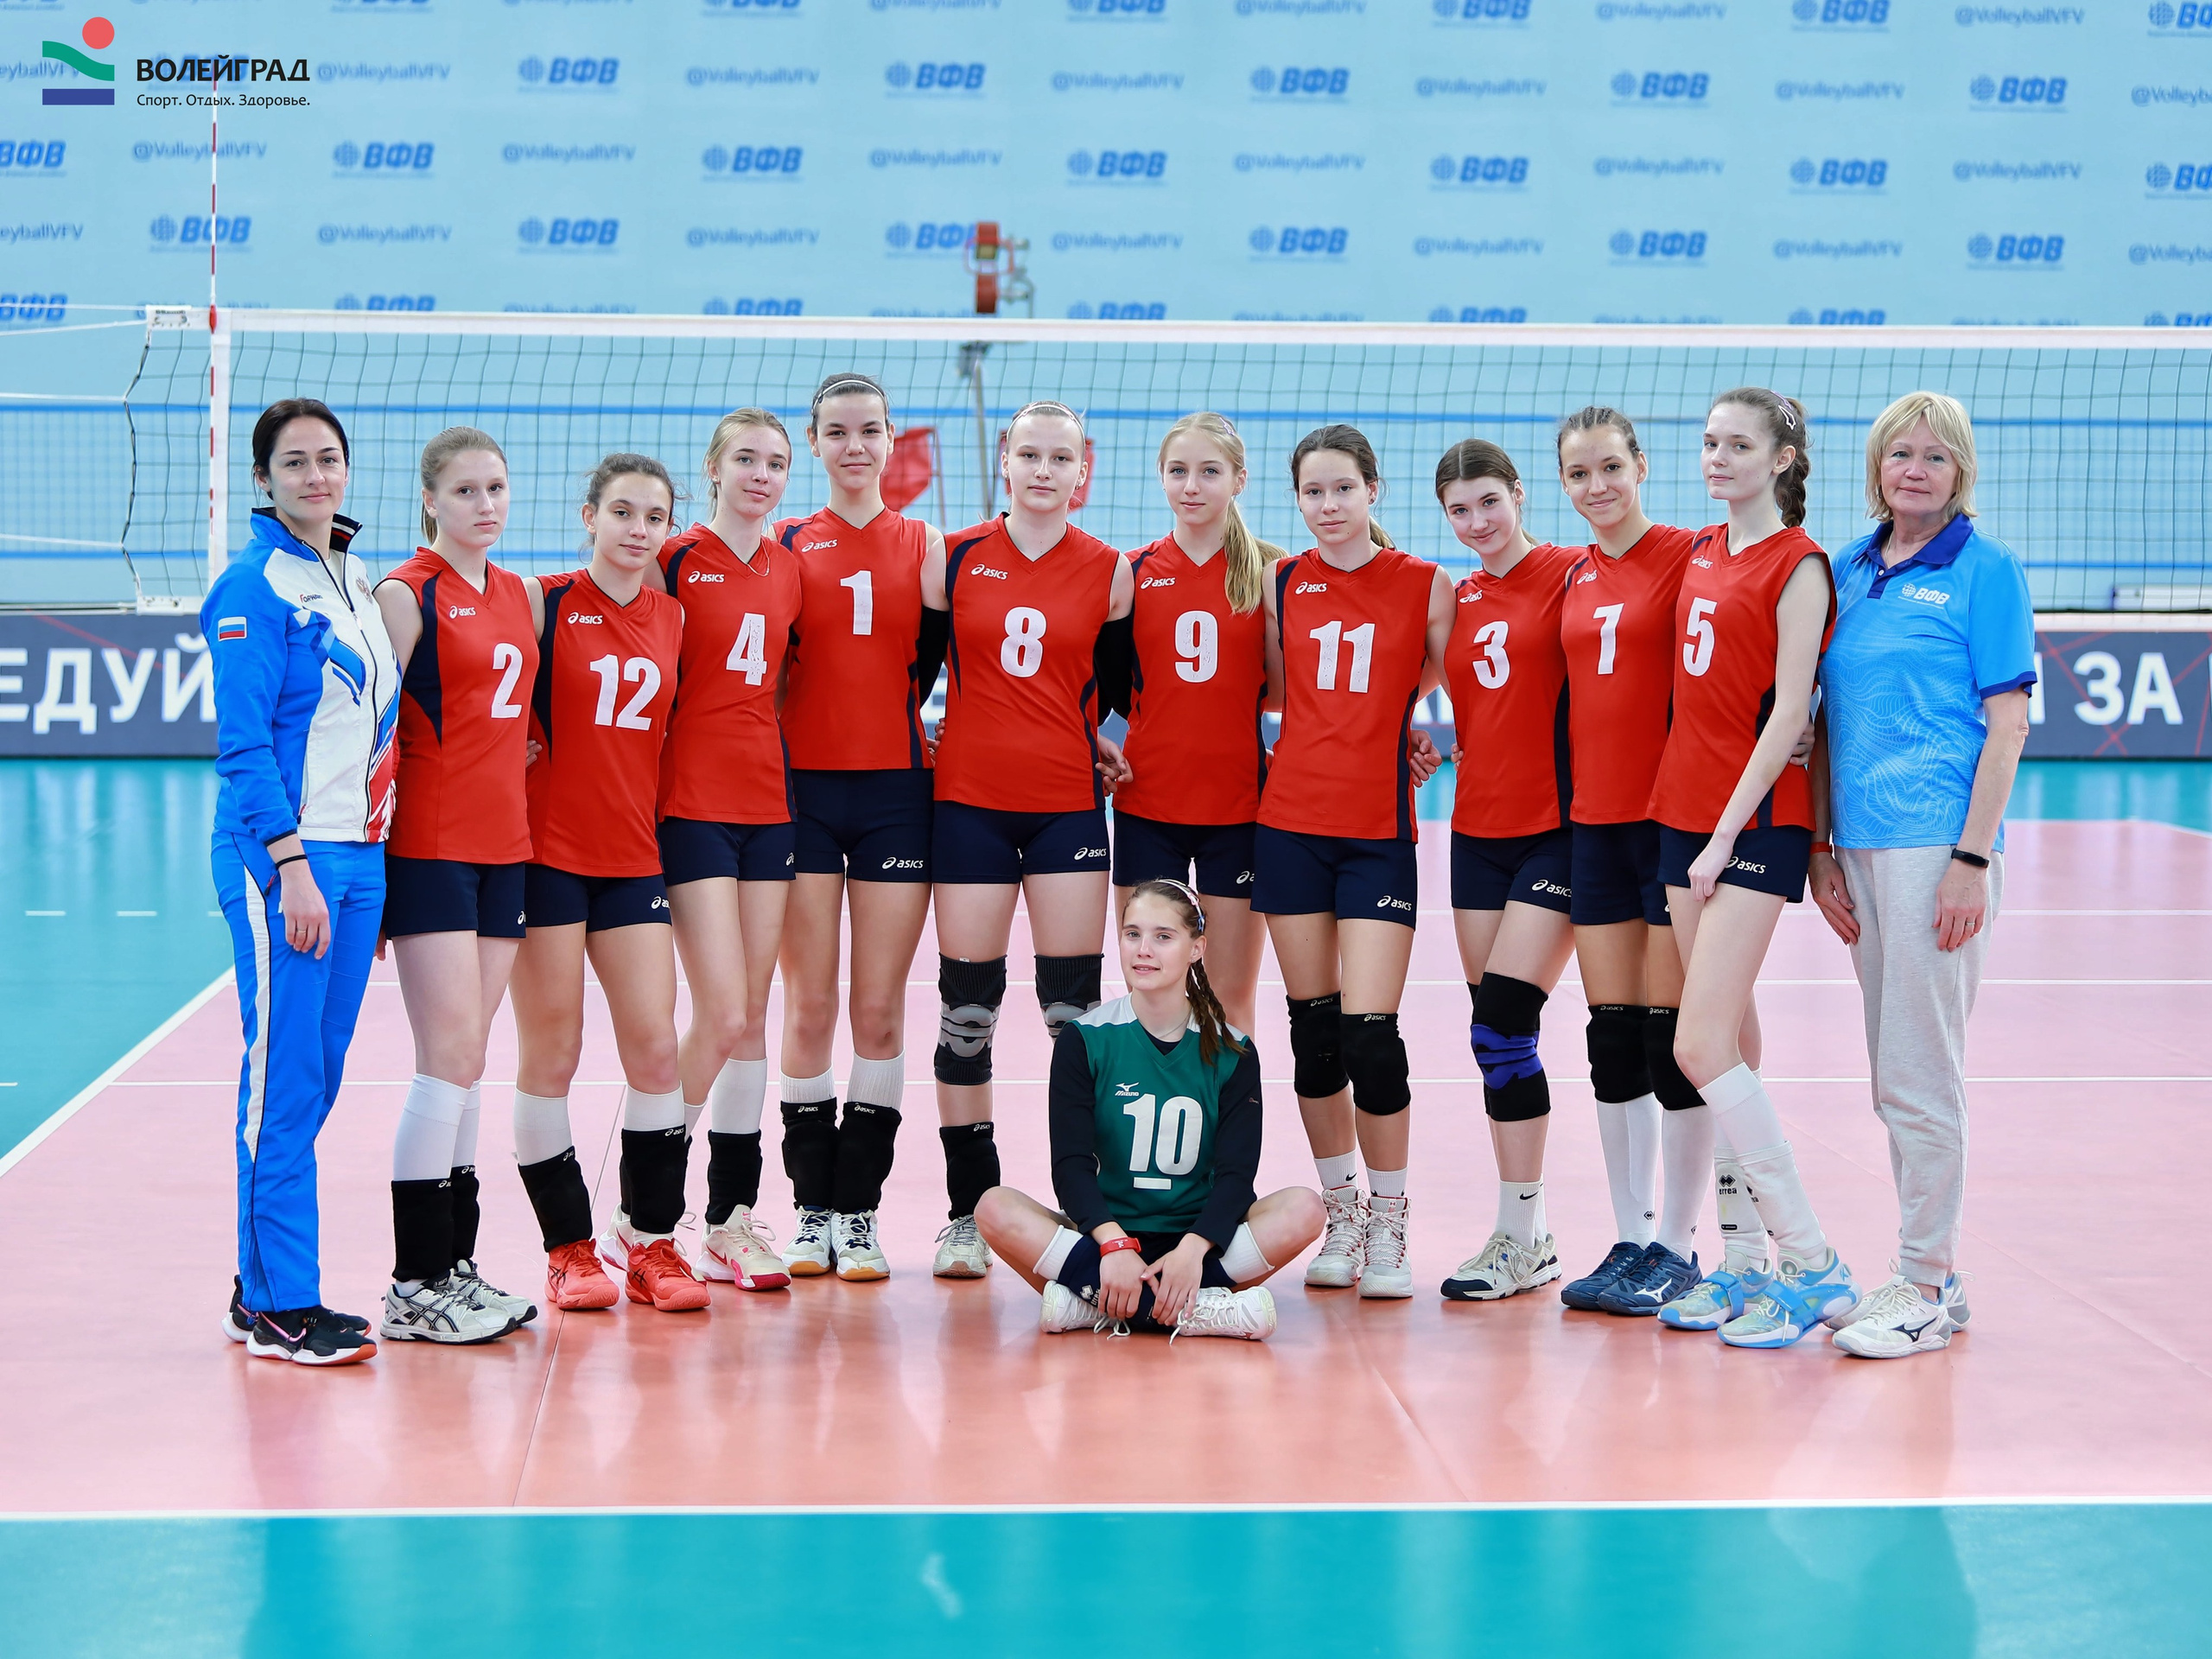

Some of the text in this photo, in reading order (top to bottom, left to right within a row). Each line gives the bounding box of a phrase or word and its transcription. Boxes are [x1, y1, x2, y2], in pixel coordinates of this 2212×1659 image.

[547, 57, 620, 86] ВФВ
[913, 62, 987, 91] ВФВ
[1278, 67, 1351, 96] ВФВ
[1639, 72, 1711, 101] ВФВ
[1998, 76, 2069, 105] ВФВ
[362, 142, 435, 171] ВФВ
[730, 145, 804, 175] ВФВ
[1096, 150, 1168, 180] ВФВ
[1458, 156, 1529, 185] ВФВ
[1818, 159, 1889, 188] ВФВ
[179, 215, 252, 245] ВФВ
[547, 218, 620, 247] ВФВ
[1277, 226, 1349, 256] ВФВ
[1637, 230, 1708, 259] ВФВ
[1995, 234, 2065, 263] ВФВ
[813, 539, 837, 550] asics
[700, 573, 725, 583] asics
[982, 567, 1008, 580] asics
[1152, 577, 1176, 588] asics
[1306, 582, 1327, 594] asics
[840, 569, 874, 636] 1
[1913, 588, 1950, 605] ВФВ
[458, 607, 476, 617] asics
[578, 613, 603, 625] asics
[726, 612, 767, 686] 4
[1001, 607, 1047, 677] 8
[1174, 610, 1218, 683] 9
[1592, 602, 1624, 675] 7
[1682, 596, 1718, 677] 5
[1309, 620, 1376, 694] 11
[1472, 620, 1510, 690] 3
[491, 642, 524, 718] 2
[589, 653, 662, 731] 12
[2074, 651, 2183, 725] ЗА
[896, 860, 924, 869] asics
[1088, 848, 1107, 857] asics
[1737, 860, 1766, 874] asics
[1390, 899, 1412, 912] asics
[1123, 1093, 1203, 1175] 10
